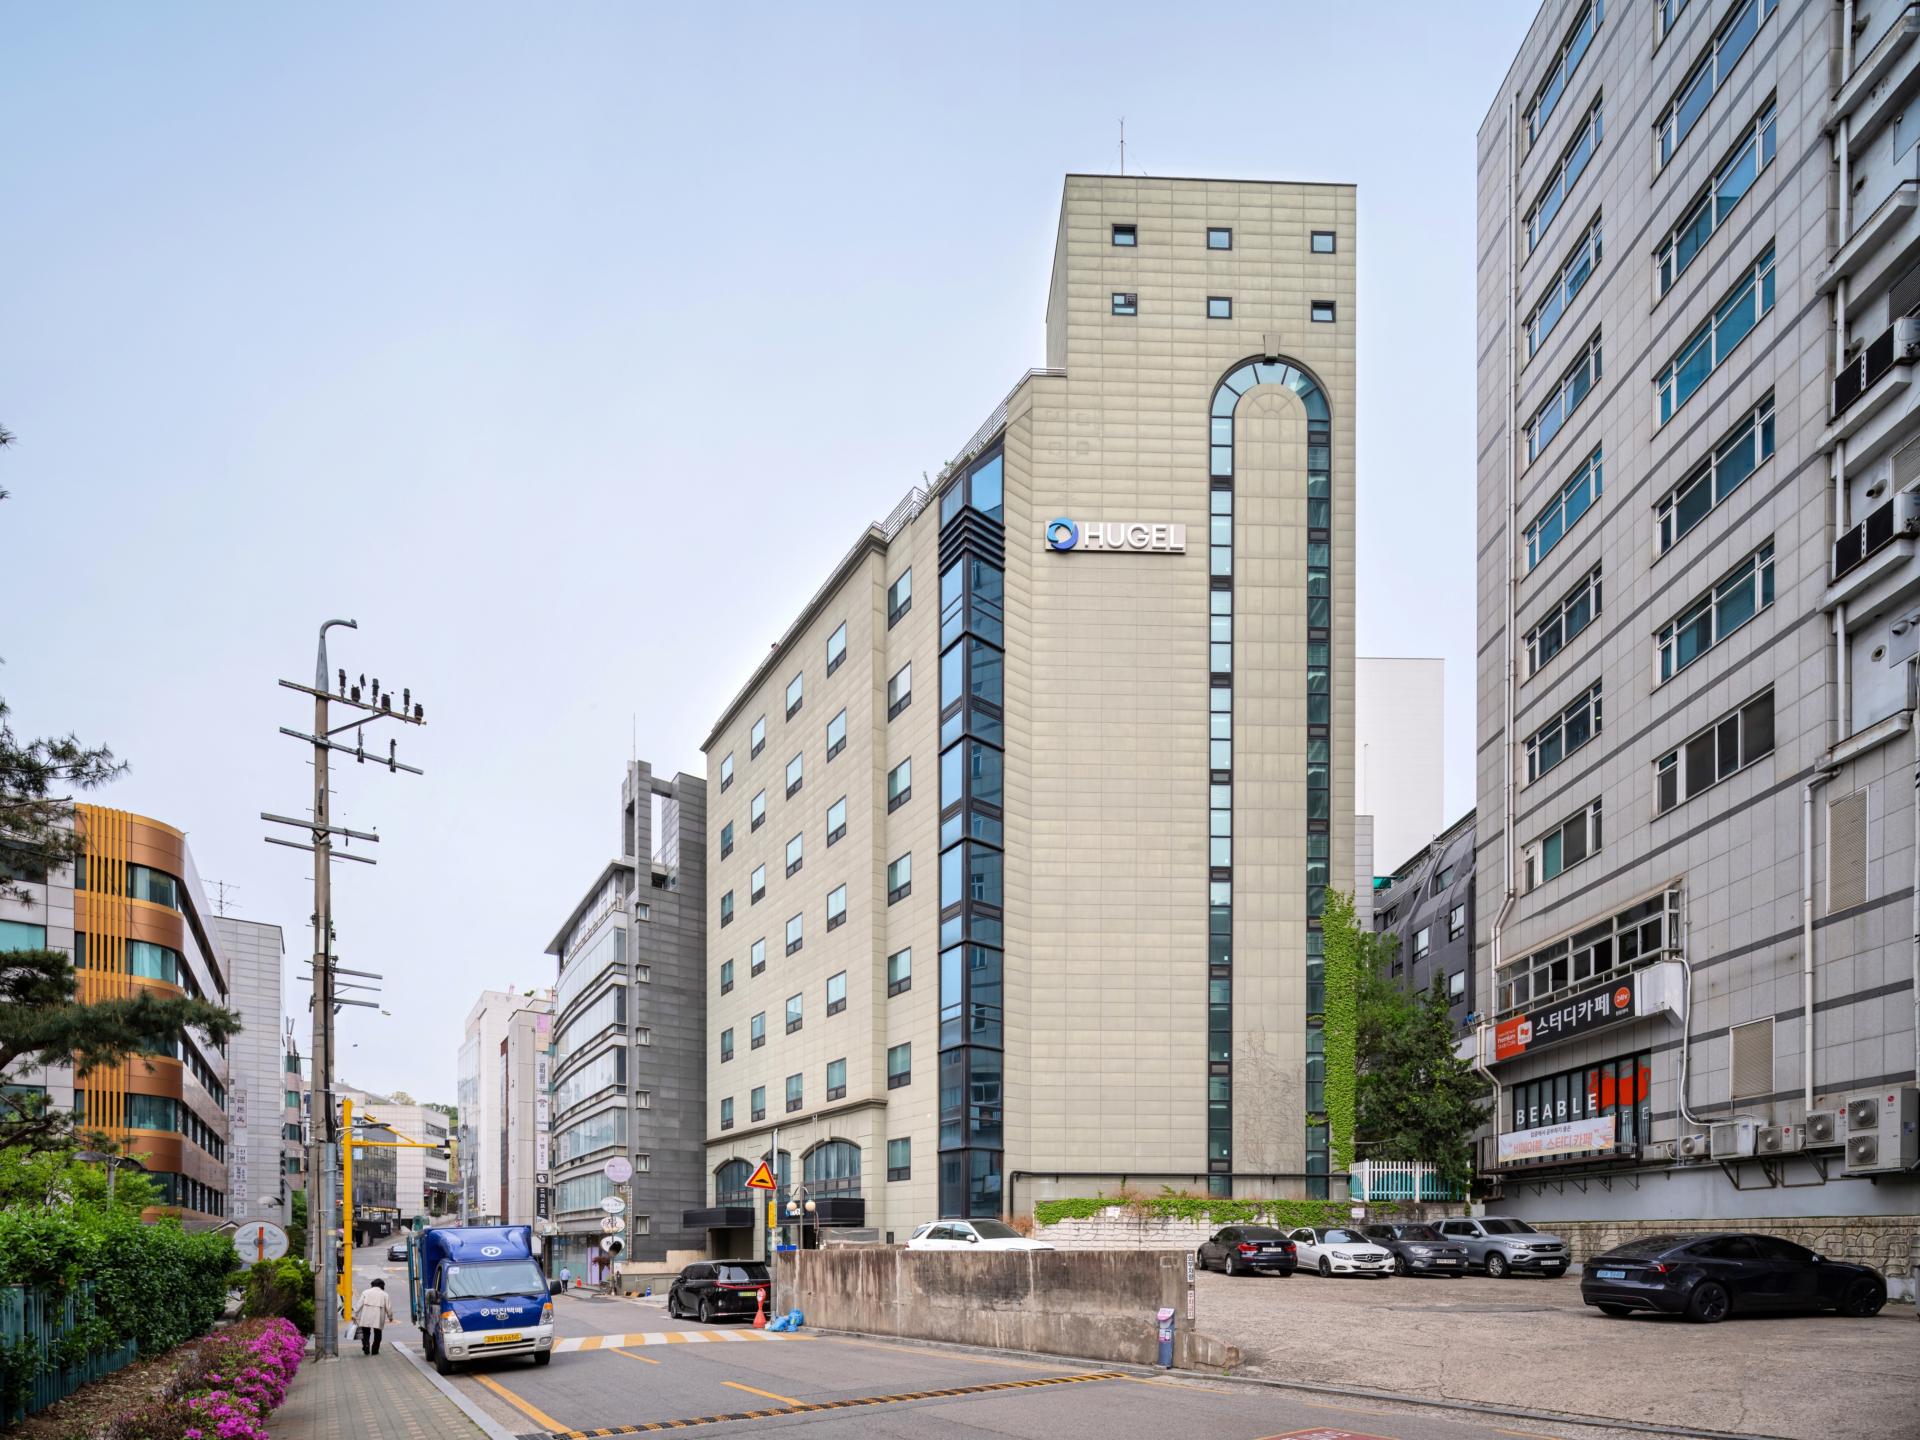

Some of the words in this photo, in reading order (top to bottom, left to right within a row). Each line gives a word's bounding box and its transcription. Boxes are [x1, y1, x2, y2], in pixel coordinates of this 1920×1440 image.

[1084, 523, 1184, 549] HUGEL
[1535, 993, 1610, 1036] 스터디카페
[1516, 1093, 1597, 1125] BEABLE
[490, 1306, 523, 1315] 한진택배
